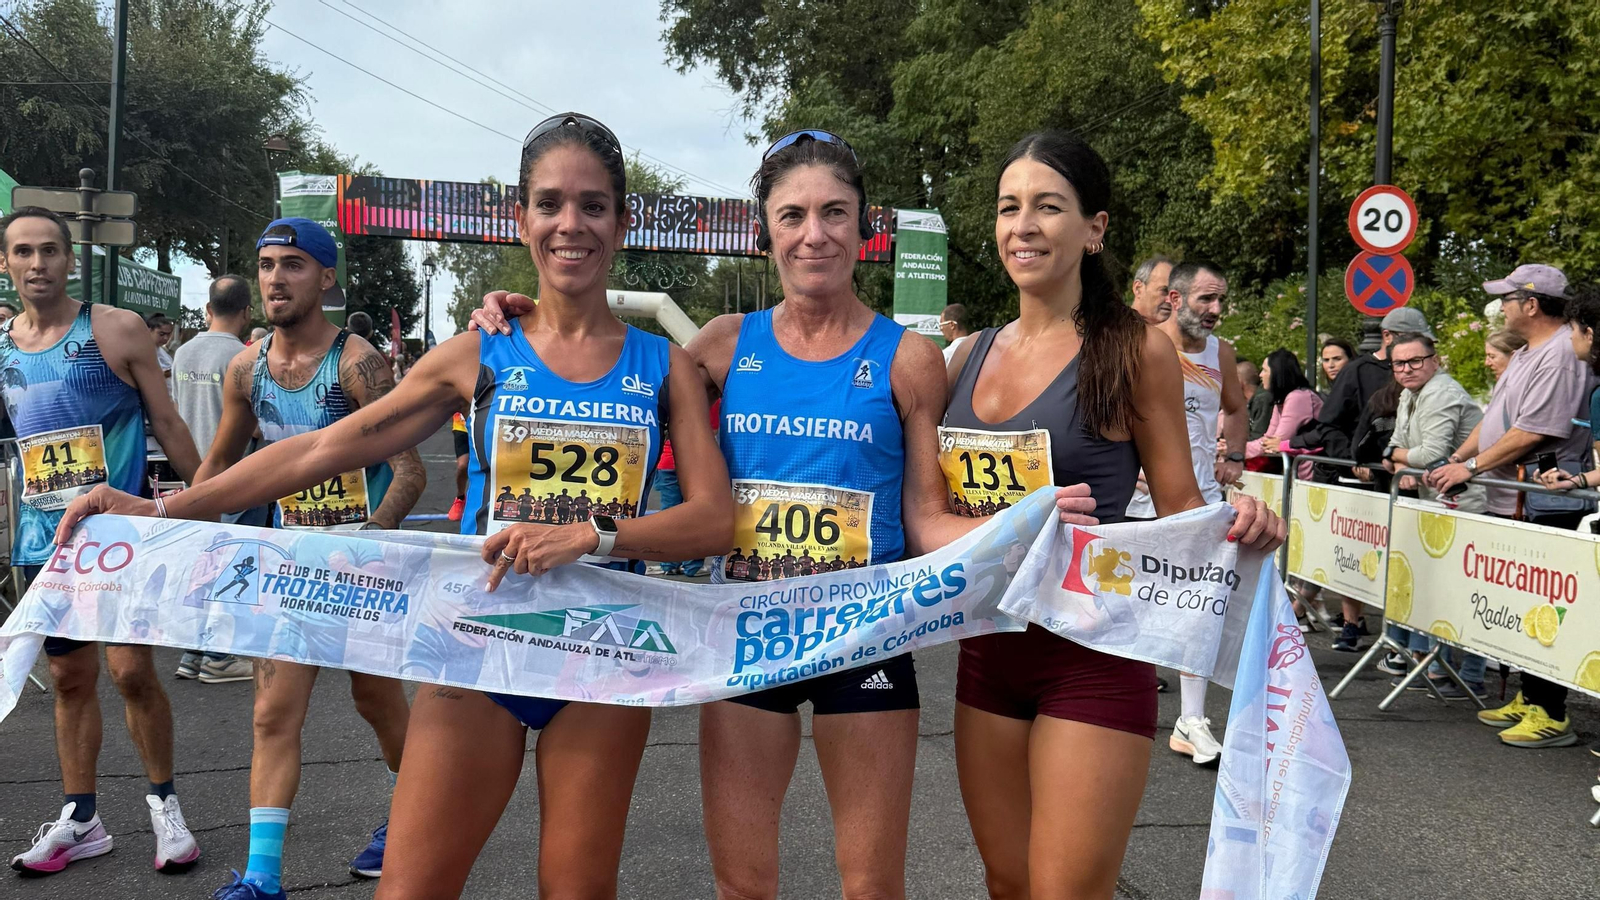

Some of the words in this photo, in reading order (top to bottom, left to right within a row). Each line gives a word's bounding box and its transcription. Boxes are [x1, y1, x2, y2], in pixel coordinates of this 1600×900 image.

[1363, 207, 1403, 233] 20
[900, 252, 943, 262] FEDERACIÓN
[902, 262, 941, 270] ANDALUZA
[907, 272, 946, 281] ATLETISMO
[497, 395, 656, 426] TROTASIERRA
[502, 424, 528, 444] 39
[529, 427, 563, 437] MEDIA
[726, 412, 874, 444] TROTASIERRA
[42, 441, 77, 467] 41
[941, 434, 956, 452] 39
[529, 442, 619, 486] 528
[959, 451, 1026, 491] 131
[737, 488, 760, 504] 39
[760, 489, 790, 498] MEDIA
[755, 503, 840, 545] 406
[1330, 507, 1388, 549] Cruzcampo
[757, 541, 785, 549] YOLANDA
[1334, 543, 1360, 572] Radler
[278, 564, 310, 578] CLUB
[314, 568, 330, 581] DE
[335, 571, 404, 592] ATLETISMO
[1463, 540, 1578, 604] Cruzcampo
[78, 581, 122, 593] Córdoba
[261, 573, 409, 615] TROTASIERRA
[740, 585, 823, 609] CIRCUITO
[829, 565, 936, 602] PROVINCIAL
[1137, 582, 1169, 606] de
[1176, 590, 1228, 616] Córd
[280, 597, 381, 622] HORNACHUELOS
[1471, 590, 1522, 633] Radler
[453, 621, 524, 644] FEDERACIÓN
[528, 637, 591, 655] ANDALUZA
[595, 648, 610, 658] DE
[726, 653, 844, 690] Diputación
[852, 646, 876, 661] de
[883, 611, 964, 651] Córdoba
[861, 681, 893, 690] adidas
